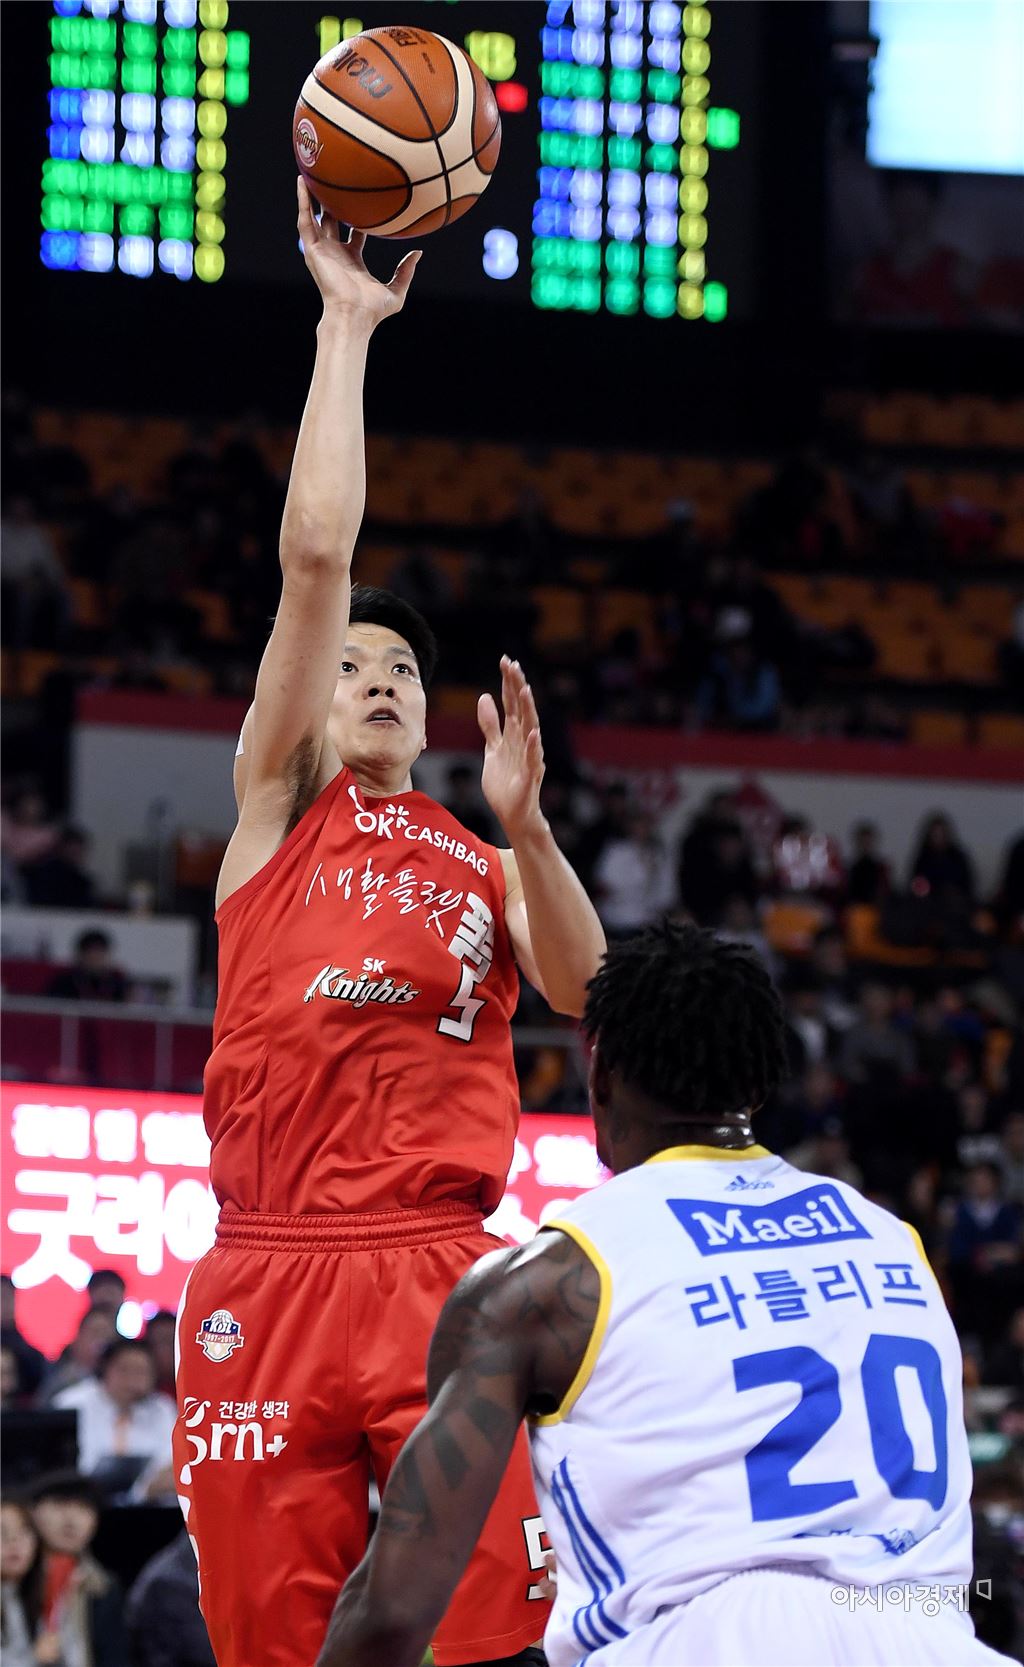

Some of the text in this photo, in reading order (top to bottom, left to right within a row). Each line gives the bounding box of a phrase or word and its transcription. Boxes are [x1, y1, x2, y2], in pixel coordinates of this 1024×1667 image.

[354, 810, 490, 878] OK CASHBAG
[303, 963, 422, 1010] Knights
[361, 957, 387, 975] SK
[690, 1194, 857, 1248] Maeil
[684, 1259, 929, 1331] 라틀리프
[261, 1400, 290, 1420] 생각
[731, 1332, 949, 1523] 20
